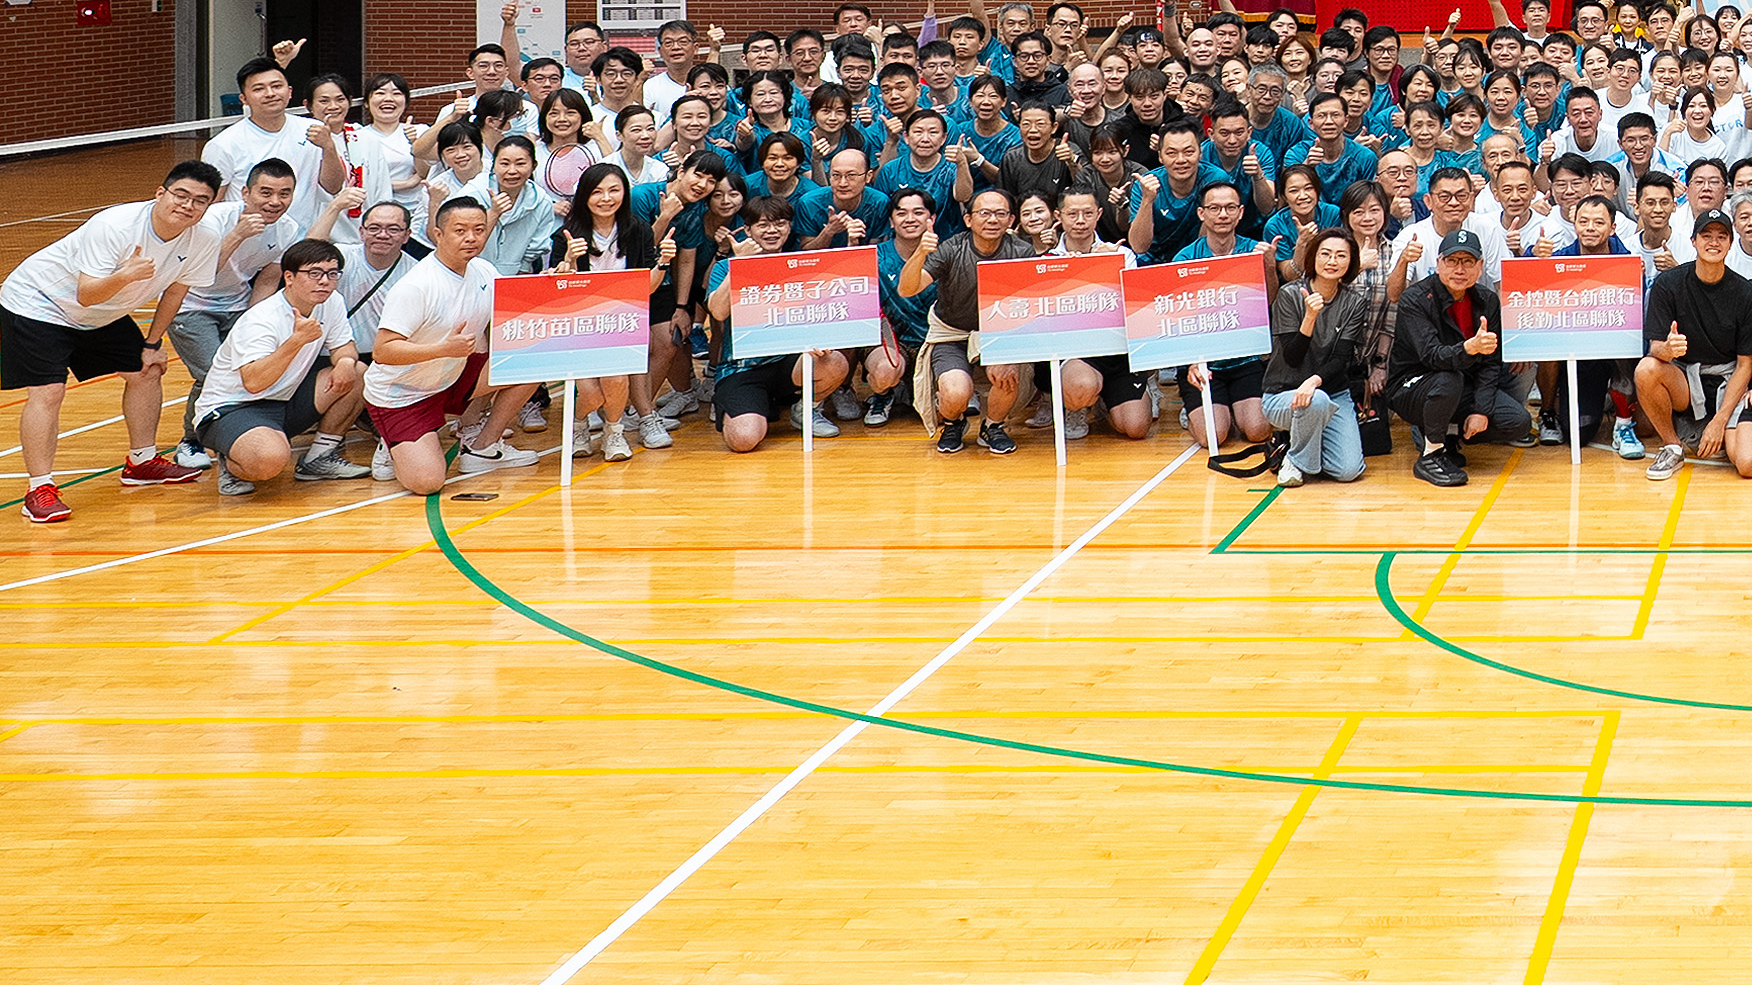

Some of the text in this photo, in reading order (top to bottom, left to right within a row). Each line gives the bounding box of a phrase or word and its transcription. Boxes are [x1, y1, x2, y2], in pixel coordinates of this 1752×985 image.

[1153, 285, 1238, 315] 新光銀行
[1507, 287, 1635, 309] 金控暨台新銀行
[763, 301, 850, 328] 北區聯隊
[1156, 310, 1241, 339] 北區聯隊
[1517, 309, 1627, 330] 後勤北區聯隊
